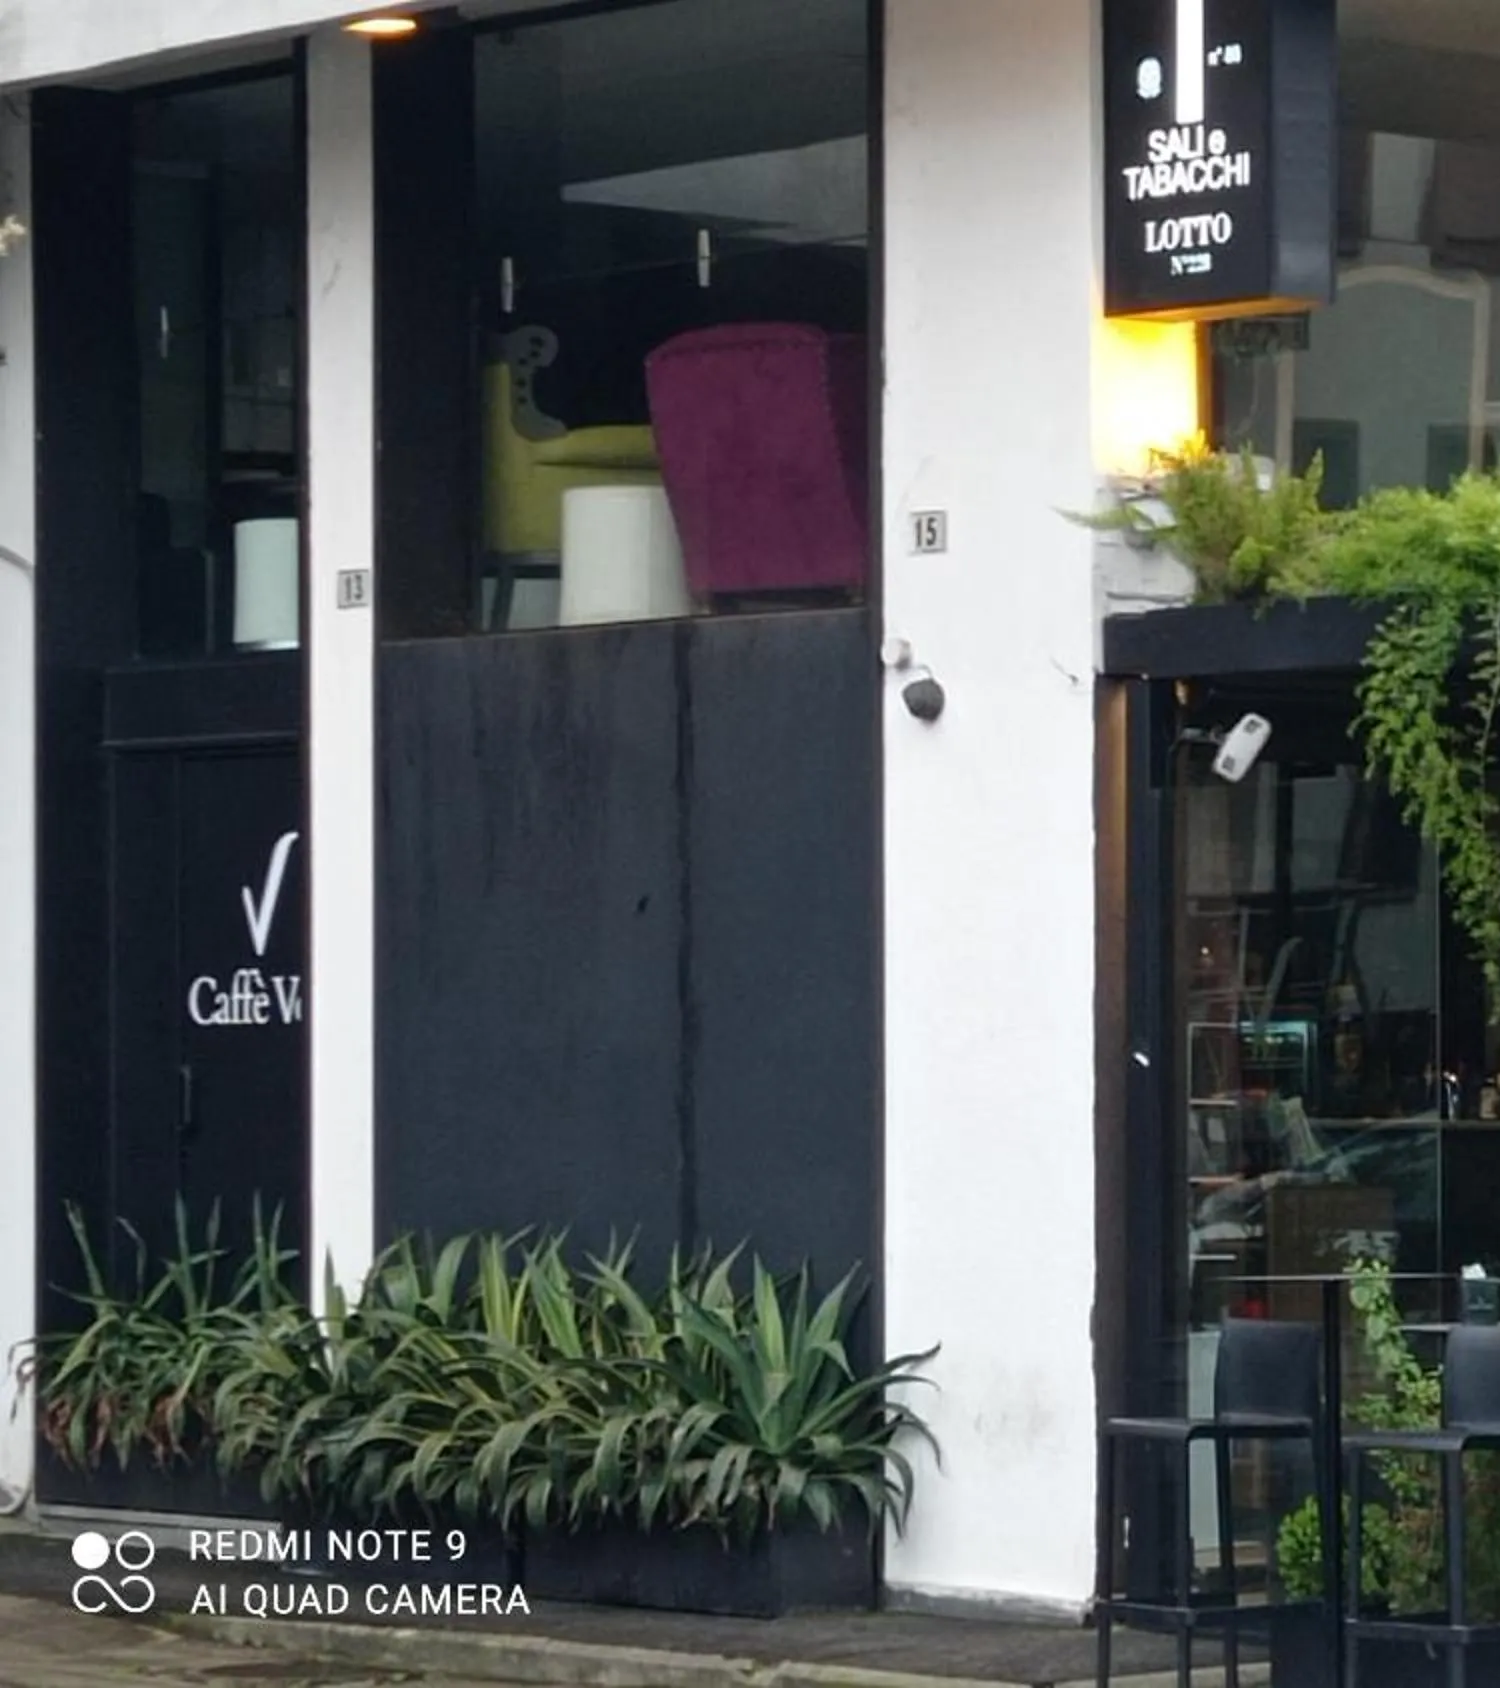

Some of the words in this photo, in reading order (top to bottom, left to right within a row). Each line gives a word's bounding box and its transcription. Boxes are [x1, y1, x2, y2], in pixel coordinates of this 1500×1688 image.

[1148, 125, 1205, 164] SALI
[1122, 151, 1251, 201] TABACCHI
[1144, 212, 1233, 253] LOTTO
[914, 516, 938, 548] 15
[186, 966, 272, 1026] Caffè
